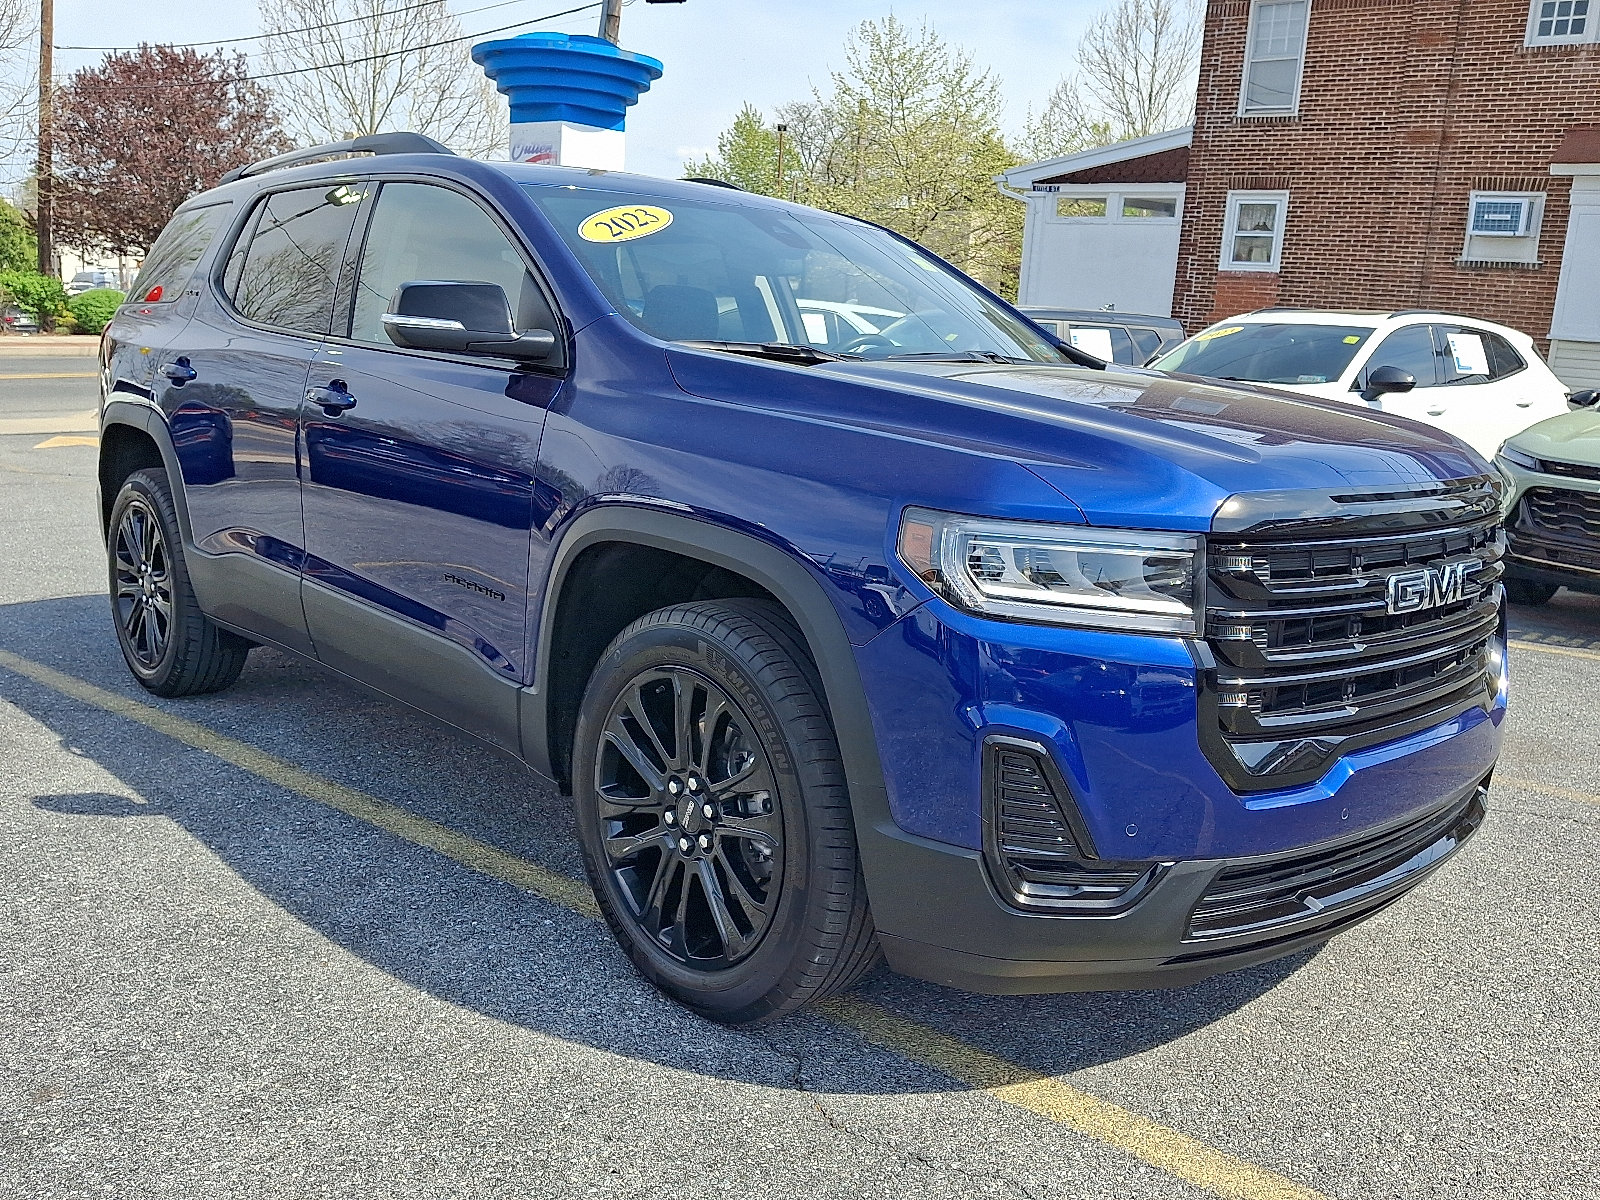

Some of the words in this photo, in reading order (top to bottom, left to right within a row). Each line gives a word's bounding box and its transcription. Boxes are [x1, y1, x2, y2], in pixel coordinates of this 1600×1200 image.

[594, 208, 660, 238] 2023
[1386, 557, 1483, 615] GMC
[727, 670, 790, 769] MICHELIN
